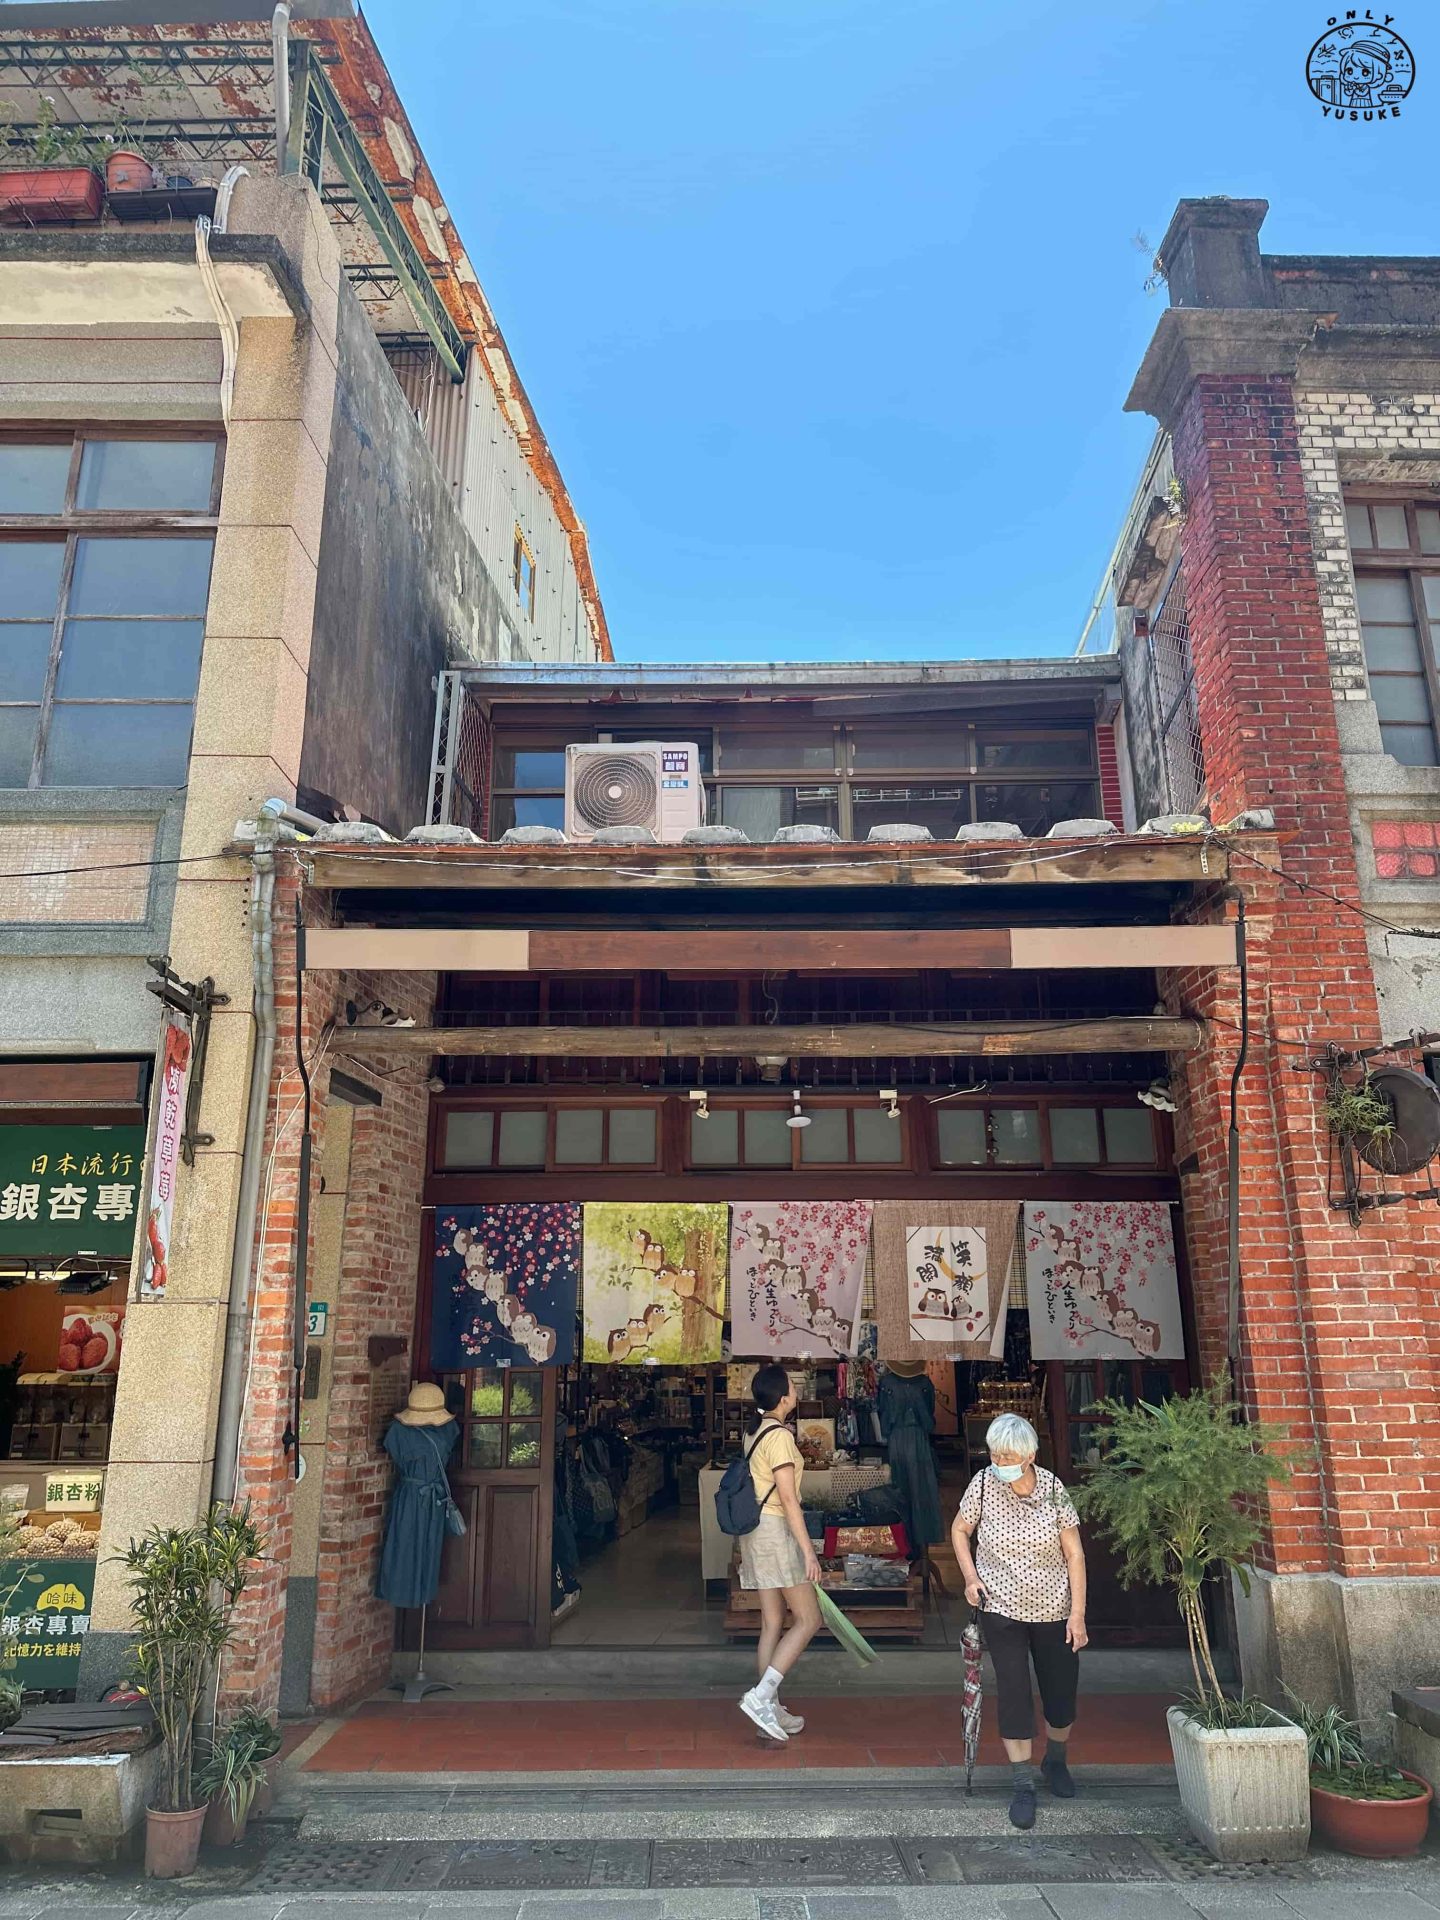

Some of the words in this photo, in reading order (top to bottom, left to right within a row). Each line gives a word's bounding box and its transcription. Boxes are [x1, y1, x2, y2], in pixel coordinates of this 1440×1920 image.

[31, 1152, 145, 1177] 日本流行
[0, 1182, 136, 1221] 銀杏專
[47, 1482, 101, 1502] 銀杏粉
[46, 1592, 77, 1605] 哈味
